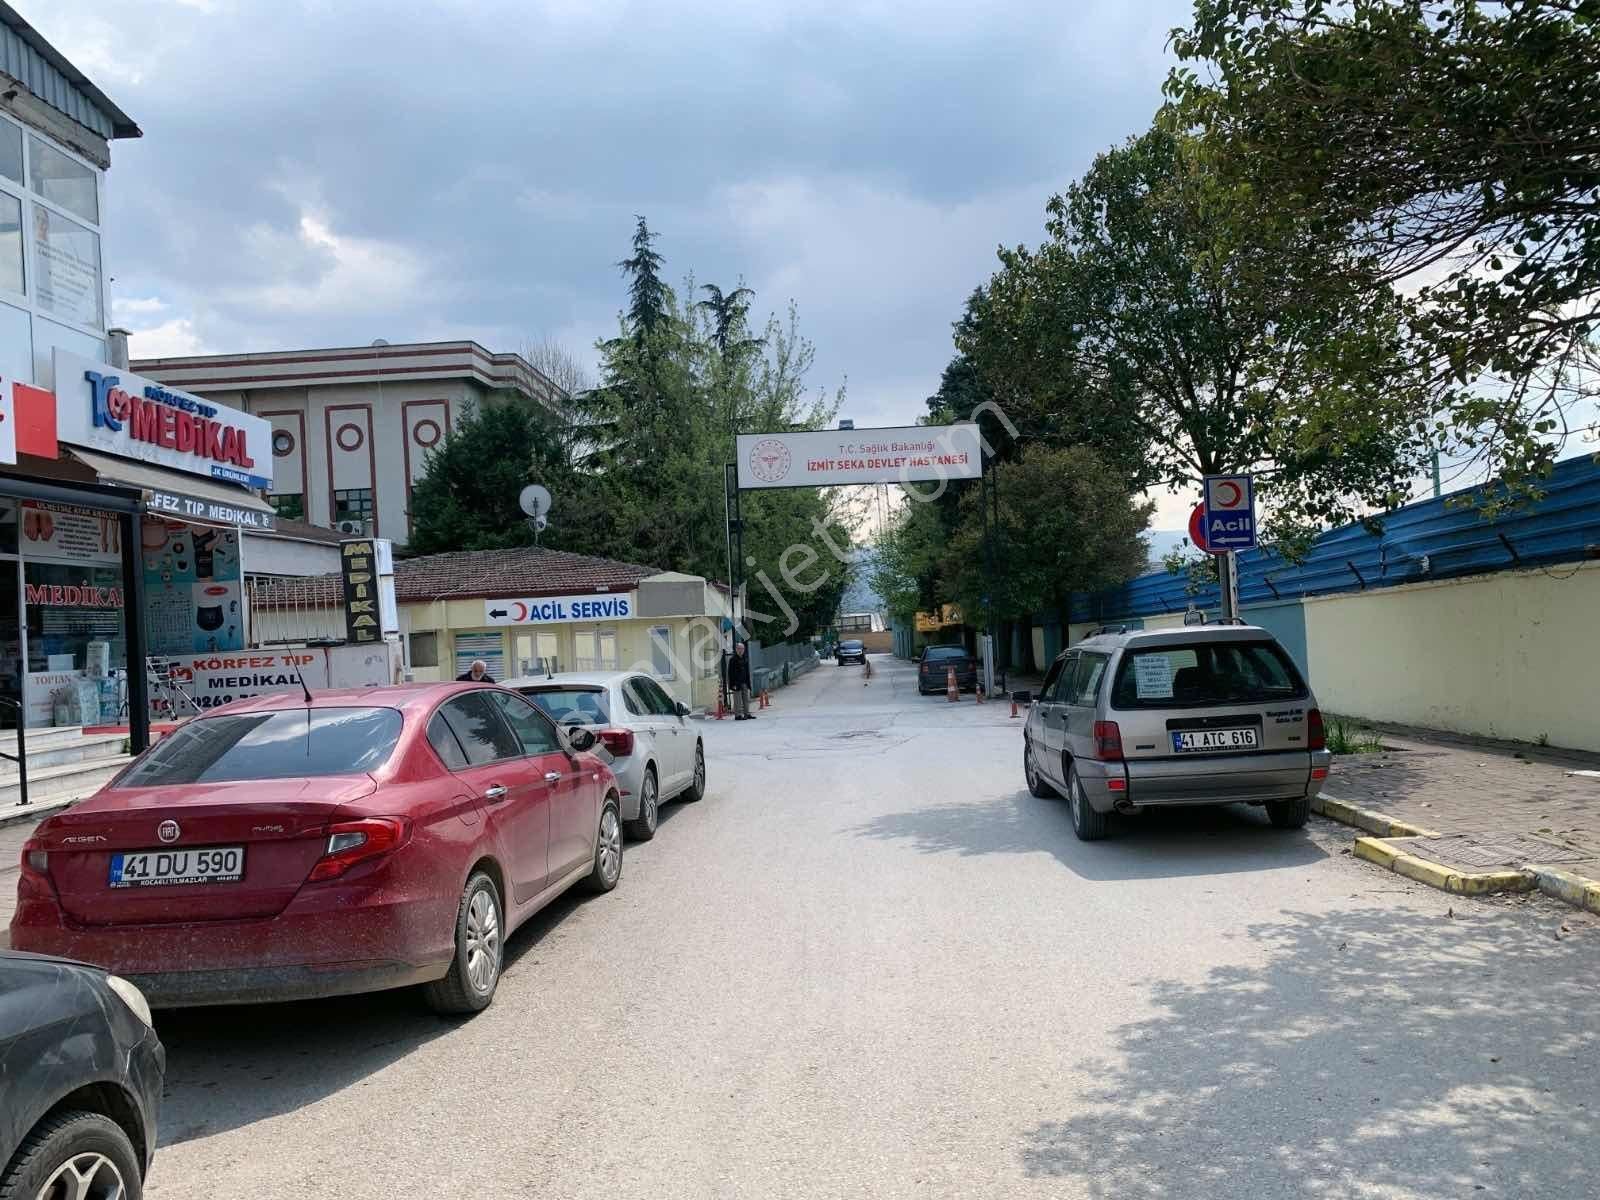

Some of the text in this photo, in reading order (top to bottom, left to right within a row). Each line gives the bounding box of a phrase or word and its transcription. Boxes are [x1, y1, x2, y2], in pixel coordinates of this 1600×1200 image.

[839, 441, 936, 455] T.C. Sağlık Bakanlığı
[807, 453, 969, 472] İZMİT SEKA DEVLET HASTANESİ
[185, 499, 205, 516] TIP
[1211, 518, 1251, 532] Acil
[530, 597, 629, 620] ACİL SERVİS
[192, 655, 275, 670] KÖRFEZ
[281, 655, 314, 666] TIP
[208, 673, 301, 689] MEDİKAL
[1182, 733, 1194, 747] 41
[1203, 732, 1225, 746] ATC
[1231, 730, 1253, 744] 616
[124, 850, 238, 878] 41 DU 590
